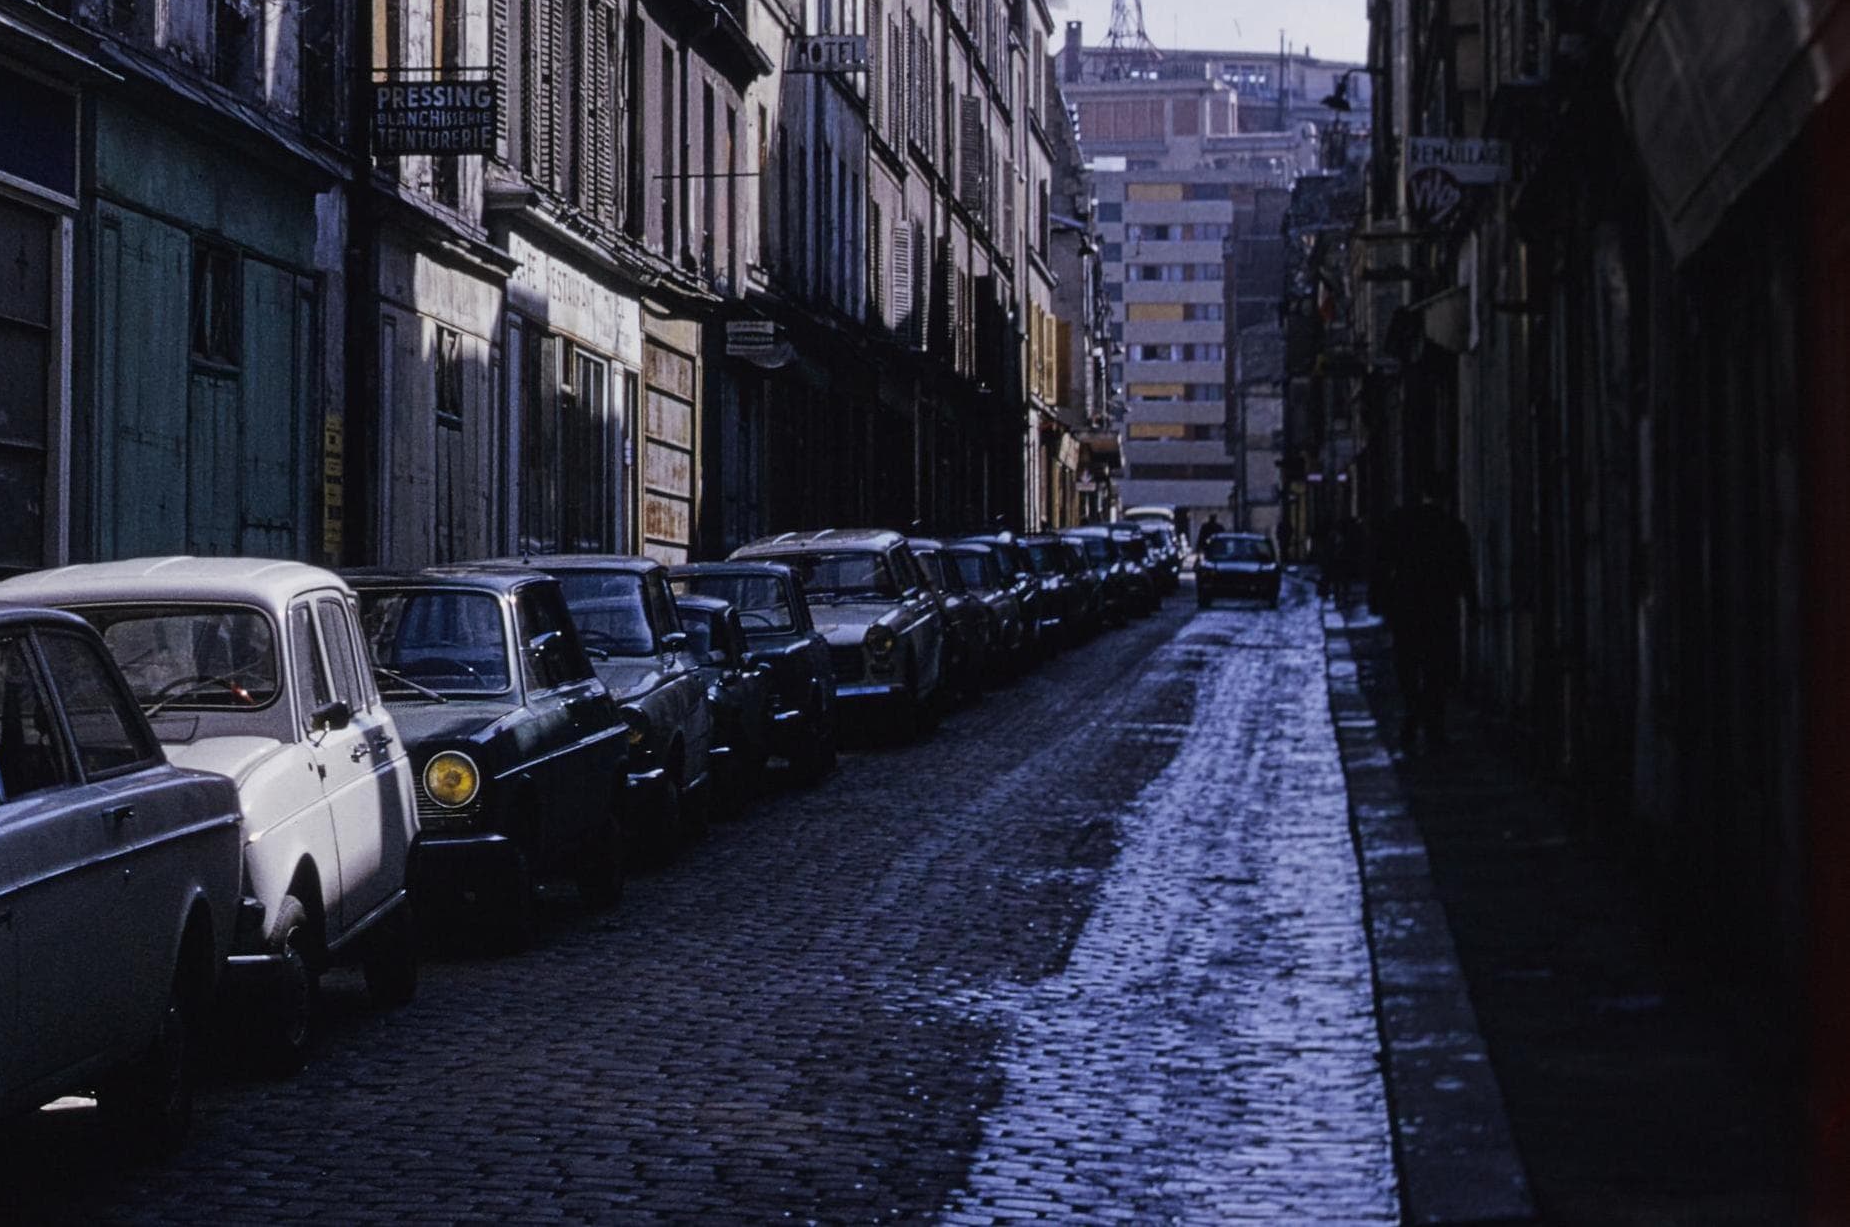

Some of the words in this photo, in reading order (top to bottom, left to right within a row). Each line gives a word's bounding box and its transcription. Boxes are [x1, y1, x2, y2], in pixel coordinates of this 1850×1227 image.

[377, 86, 492, 109] PRESSING
[377, 111, 492, 127] BLANCHISSERIE
[377, 126, 492, 149] TEINTURERIE
